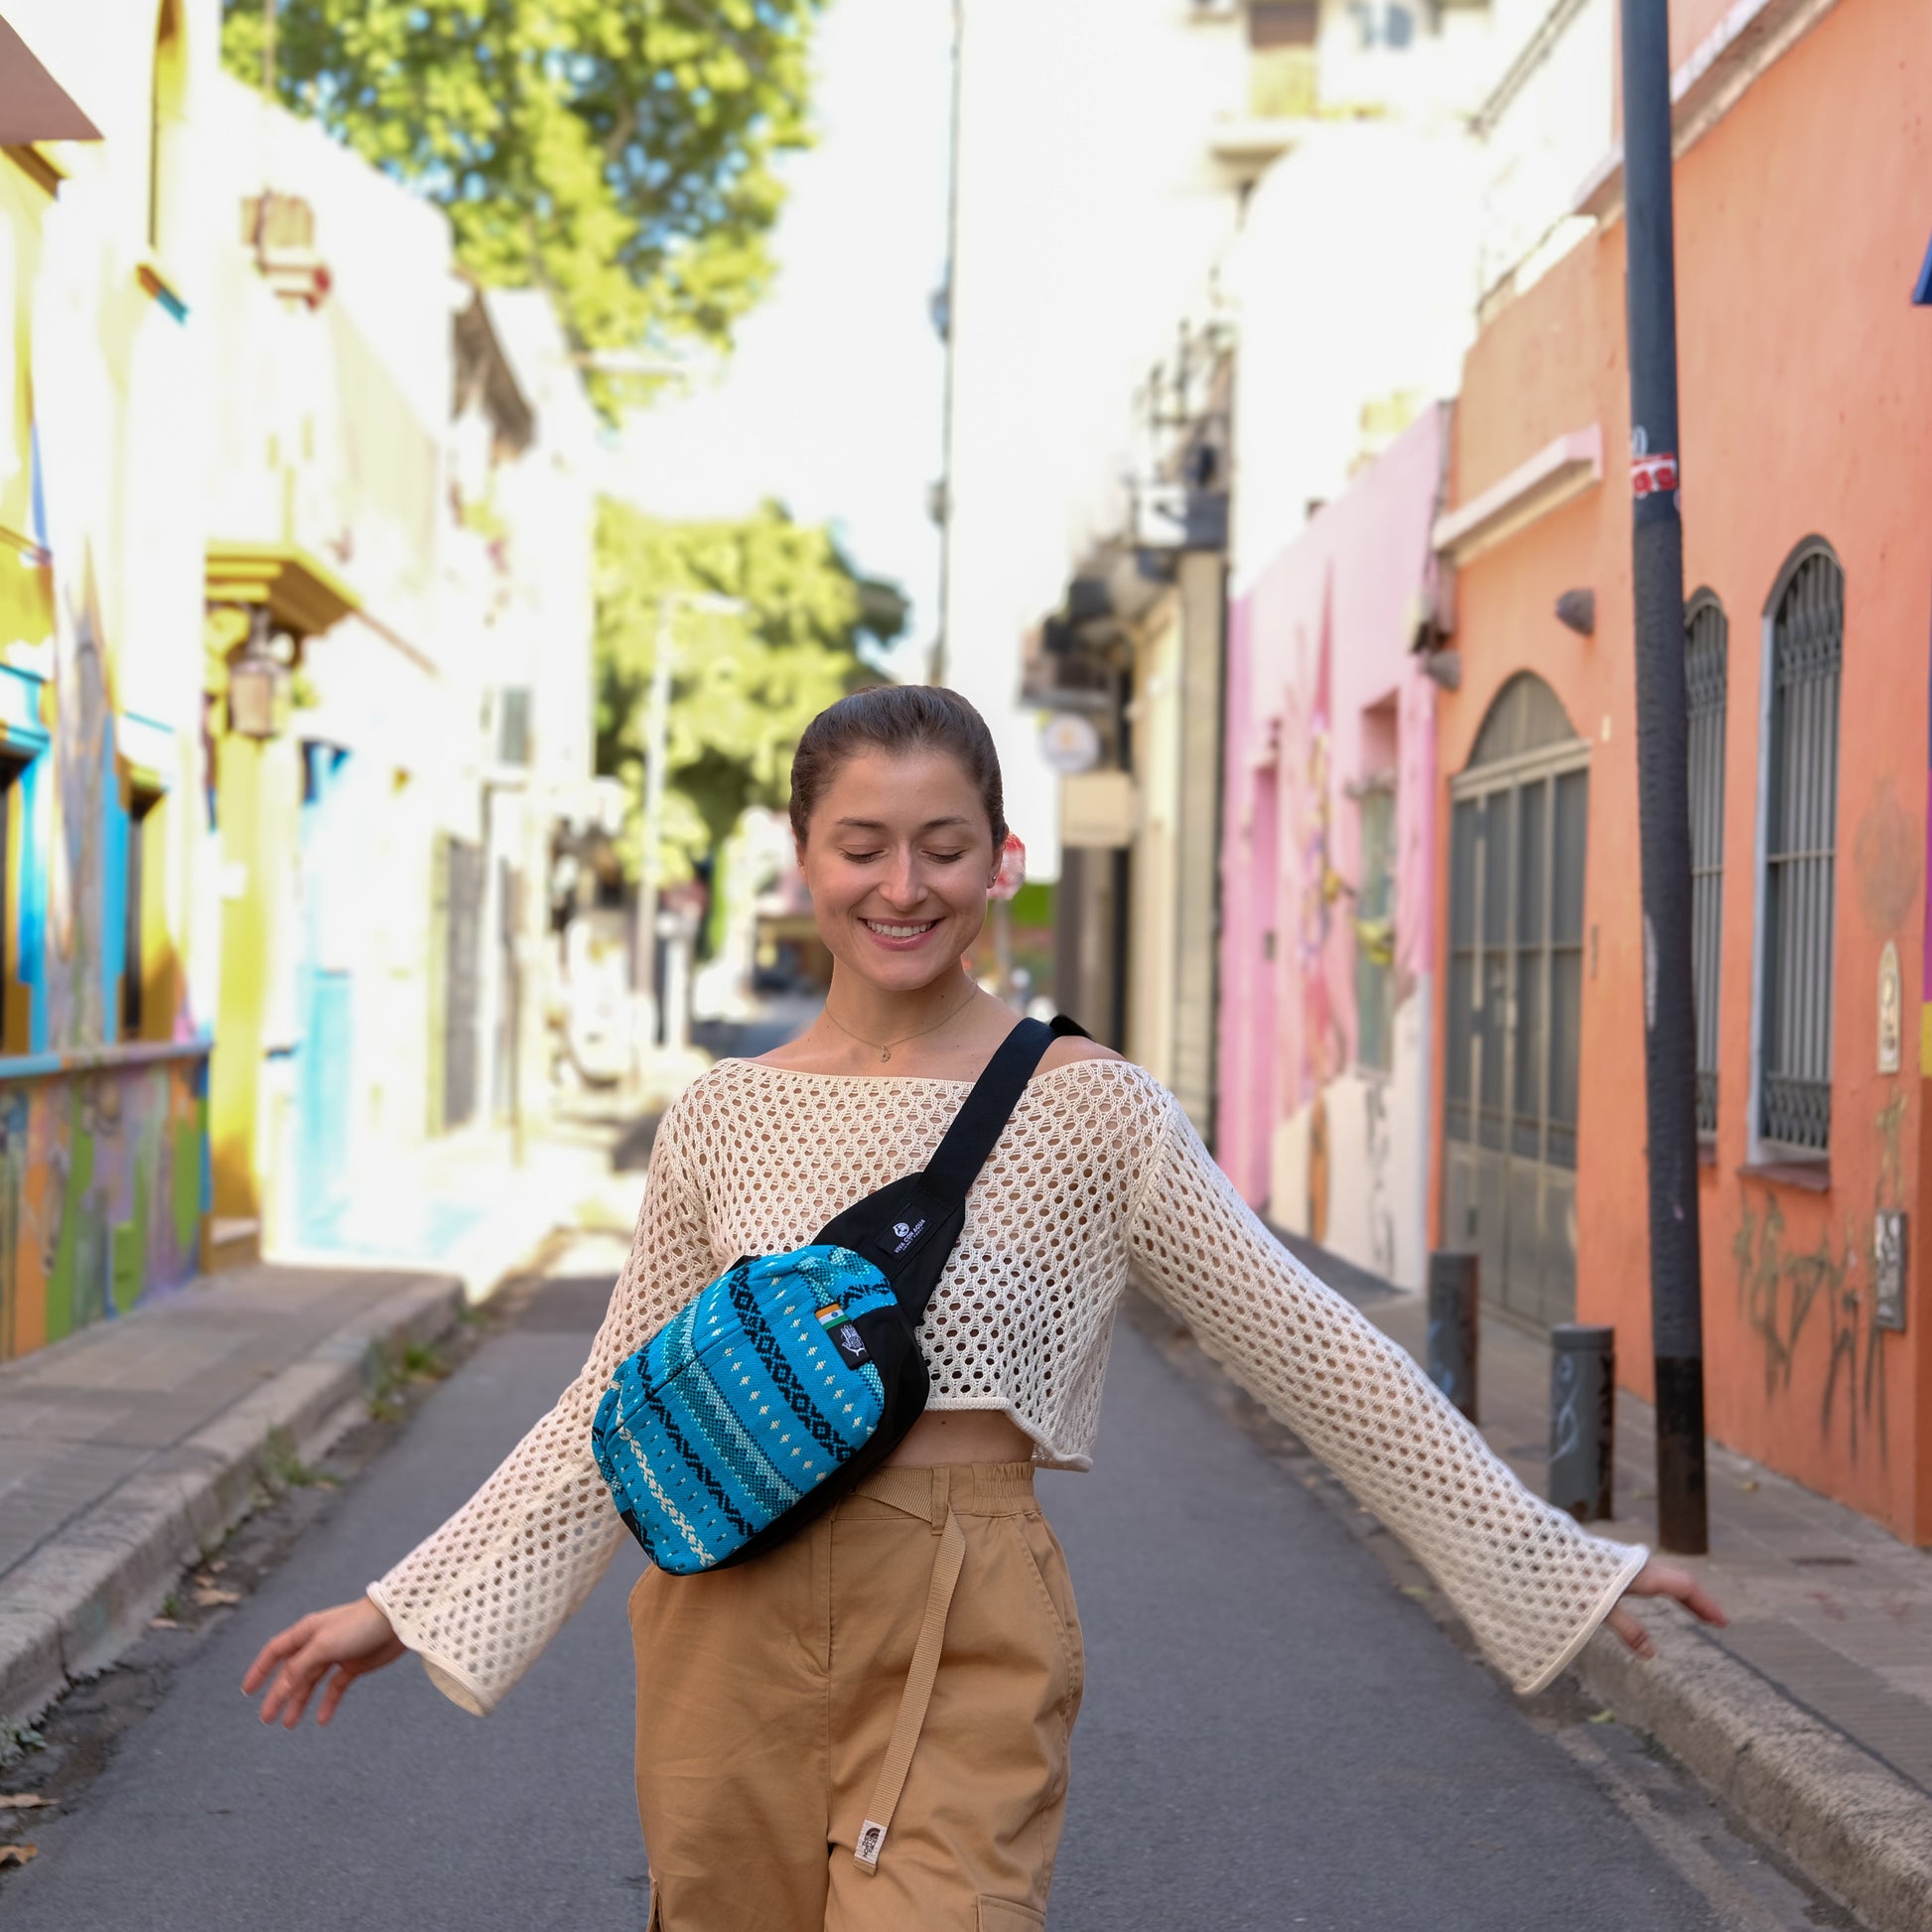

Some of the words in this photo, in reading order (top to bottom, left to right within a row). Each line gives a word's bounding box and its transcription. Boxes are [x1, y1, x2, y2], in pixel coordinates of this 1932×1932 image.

[894, 1241, 905, 1253] VIVA
[903, 1231, 914, 1242] CON
[912, 1218, 925, 1232] AGUA
